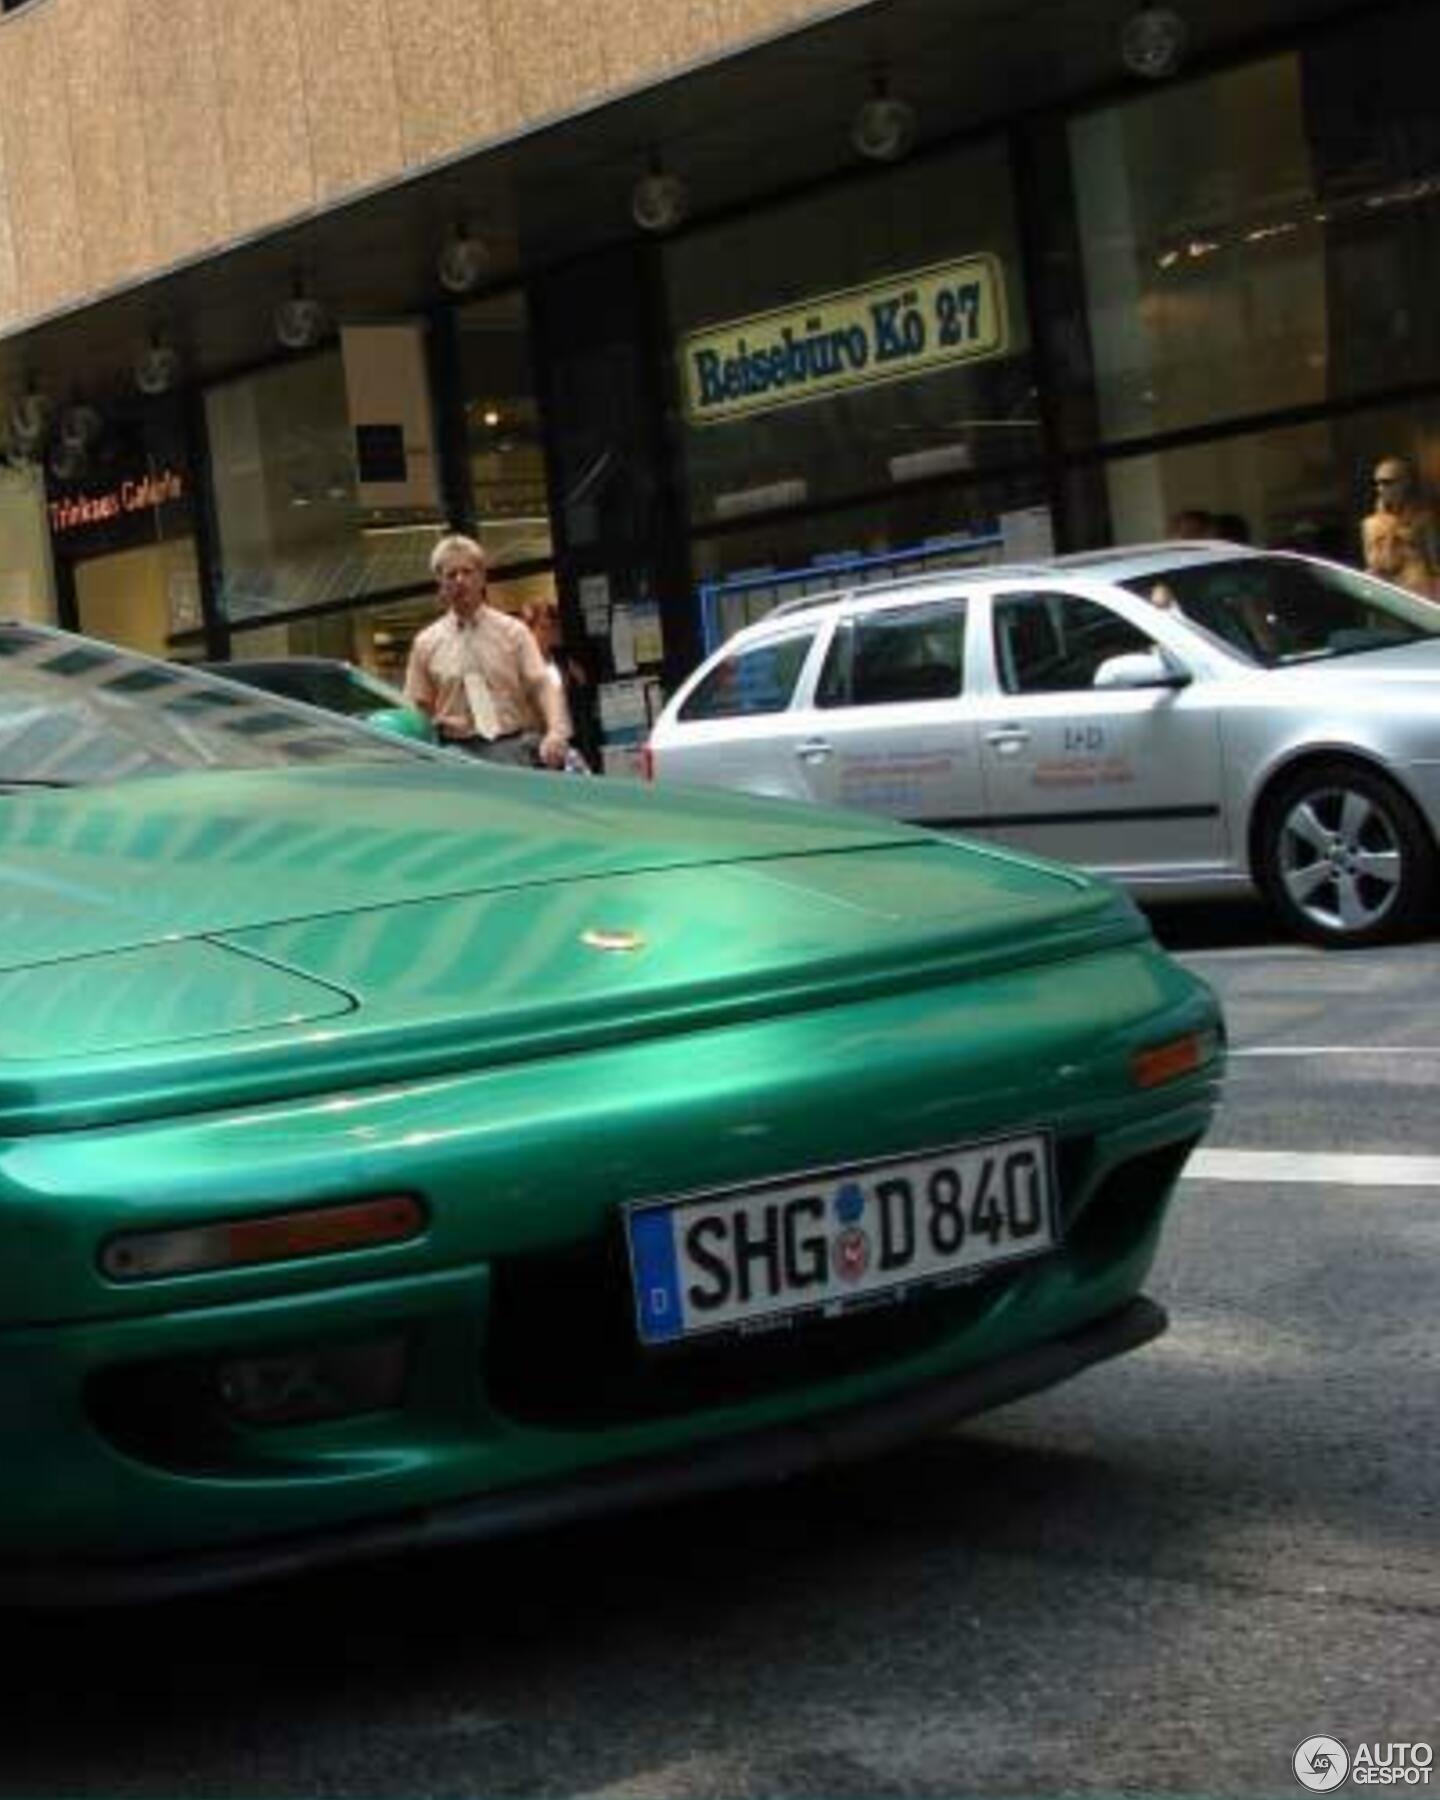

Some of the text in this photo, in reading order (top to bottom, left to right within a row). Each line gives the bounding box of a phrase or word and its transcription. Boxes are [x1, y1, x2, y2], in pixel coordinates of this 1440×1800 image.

[694, 281, 981, 406] Reisebüro Kö 27
[685, 1196, 828, 1310] SHG
[927, 1151, 1042, 1255] 840
[651, 1287, 665, 1315] D
